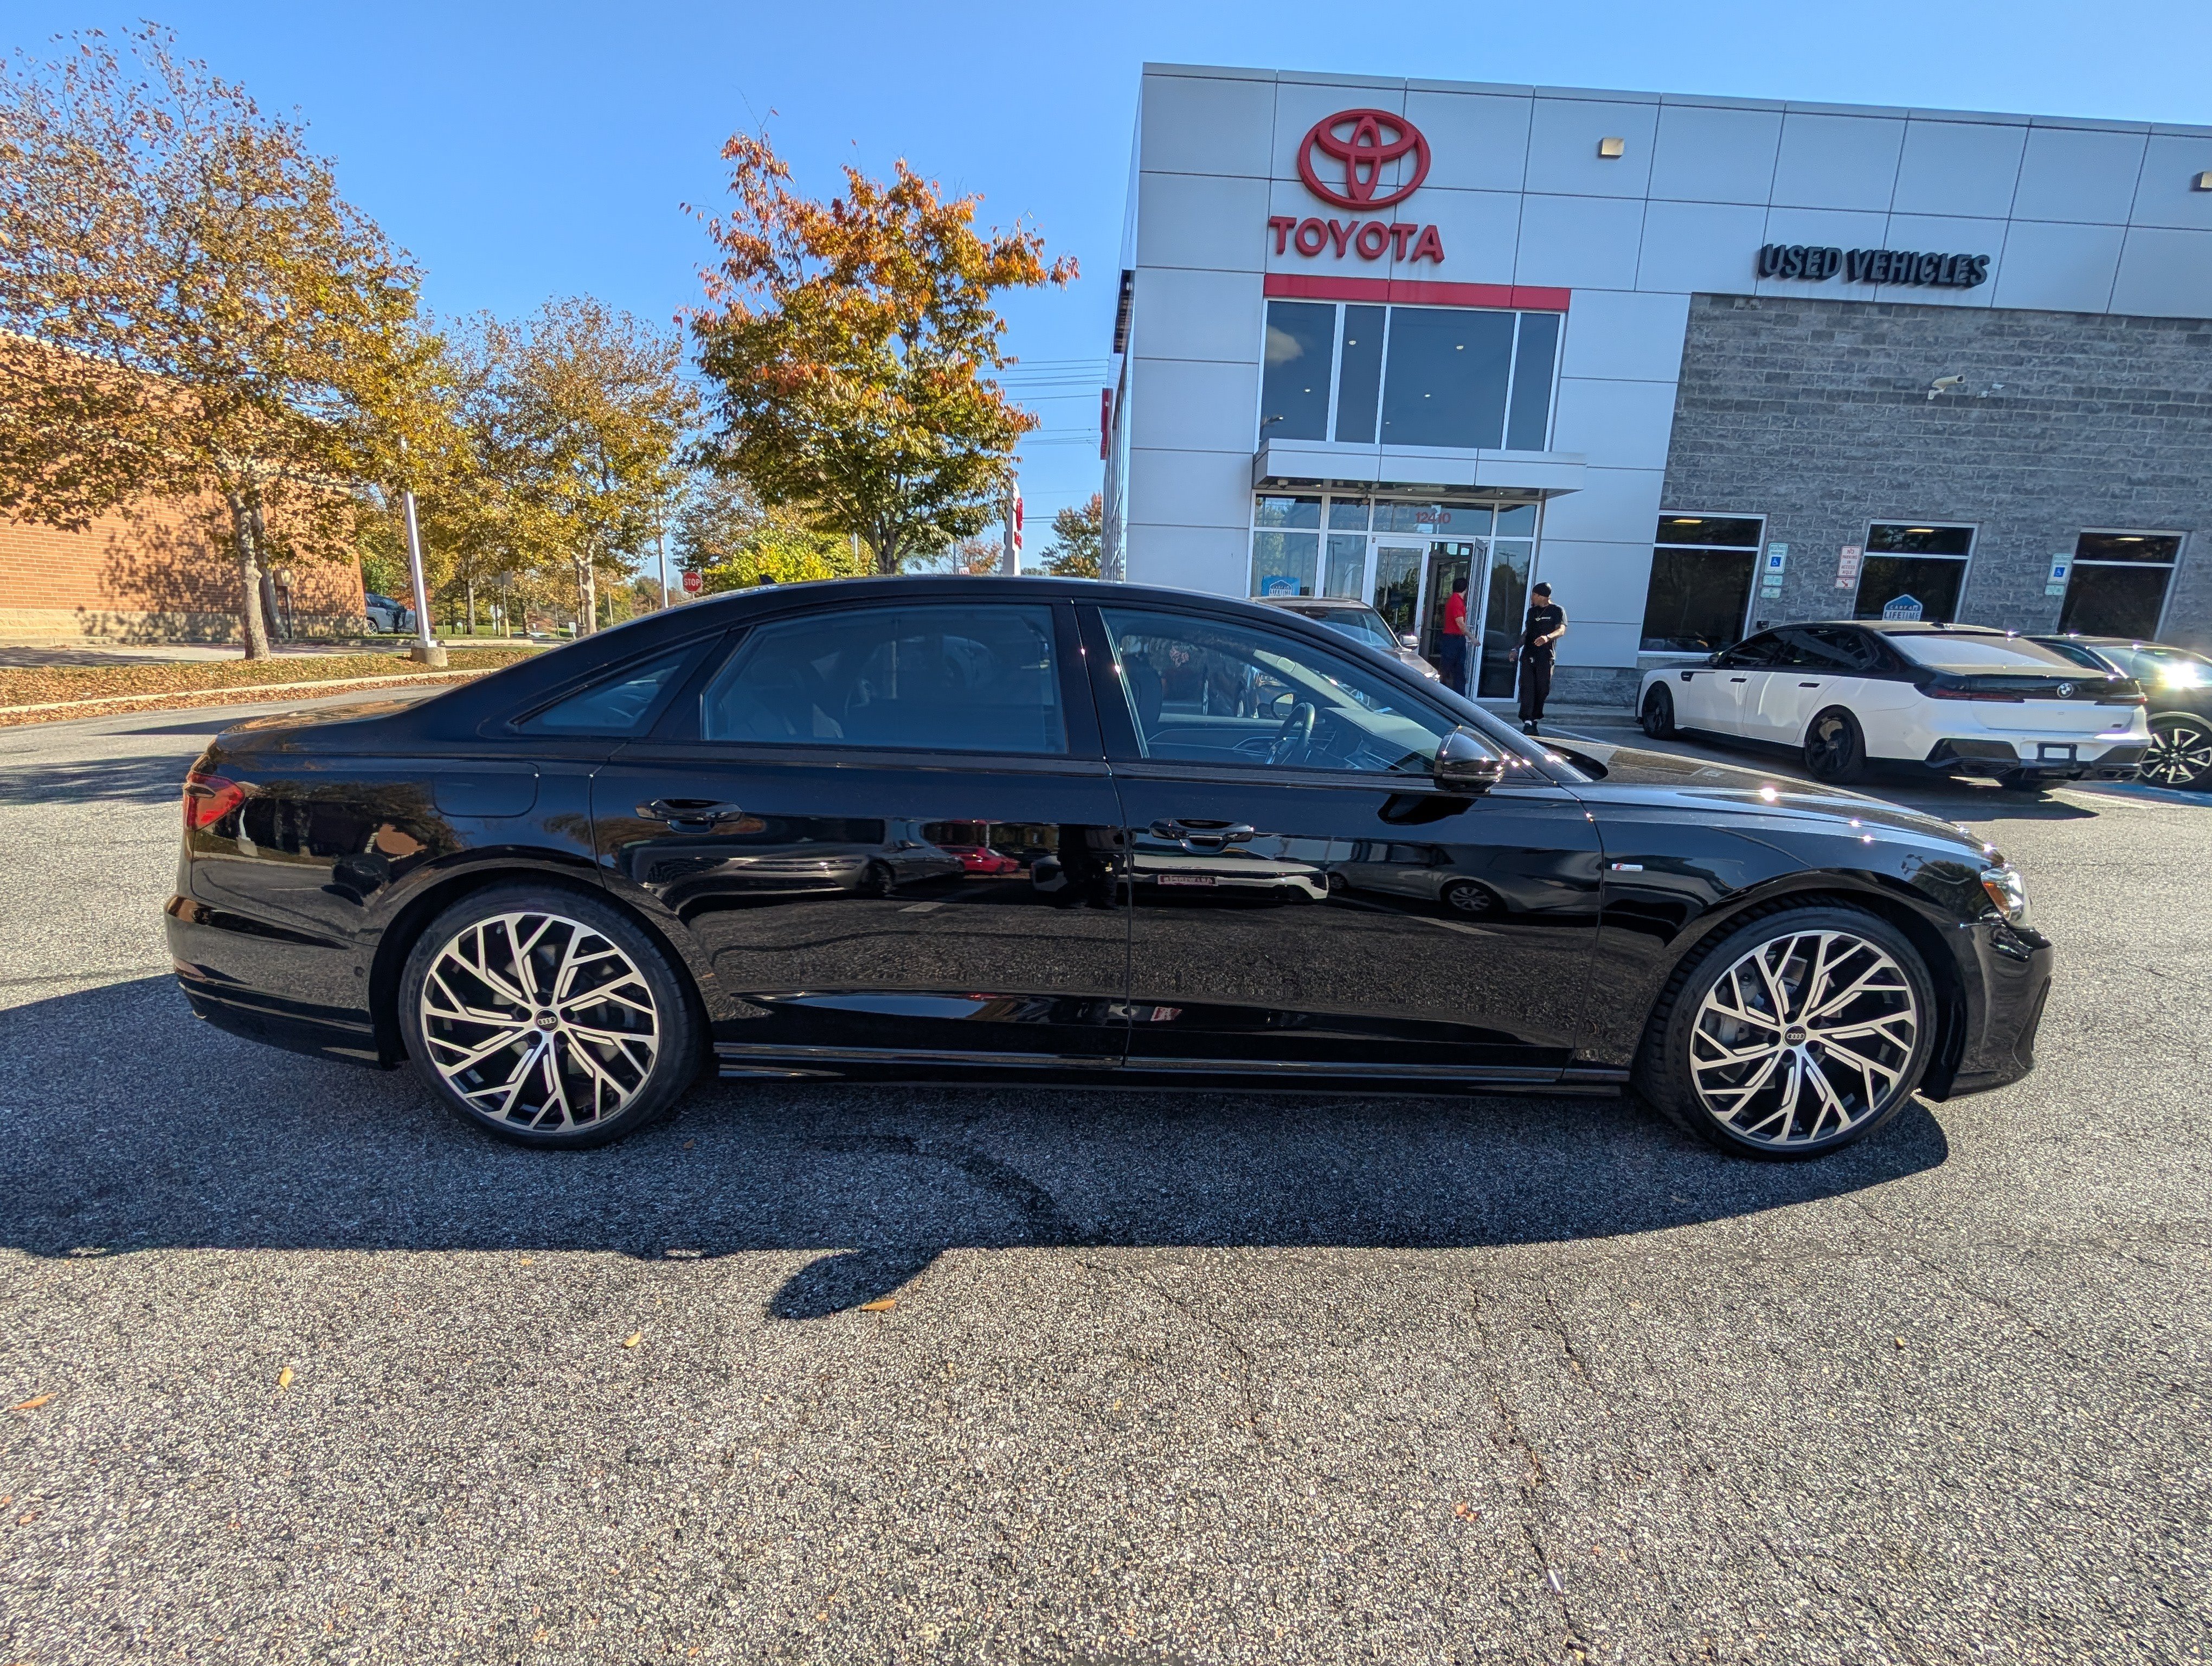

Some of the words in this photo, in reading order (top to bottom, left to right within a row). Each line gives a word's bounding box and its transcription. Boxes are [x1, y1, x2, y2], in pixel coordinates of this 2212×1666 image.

[1269, 216, 1445, 264] TOYOTA
[1759, 244, 1843, 280] USED
[1846, 248, 1990, 287] VEHICLES
[1416, 511, 1451, 524] 12410
[684, 578, 700, 586] STOP
[1884, 611, 1920, 620] LIFETIME
